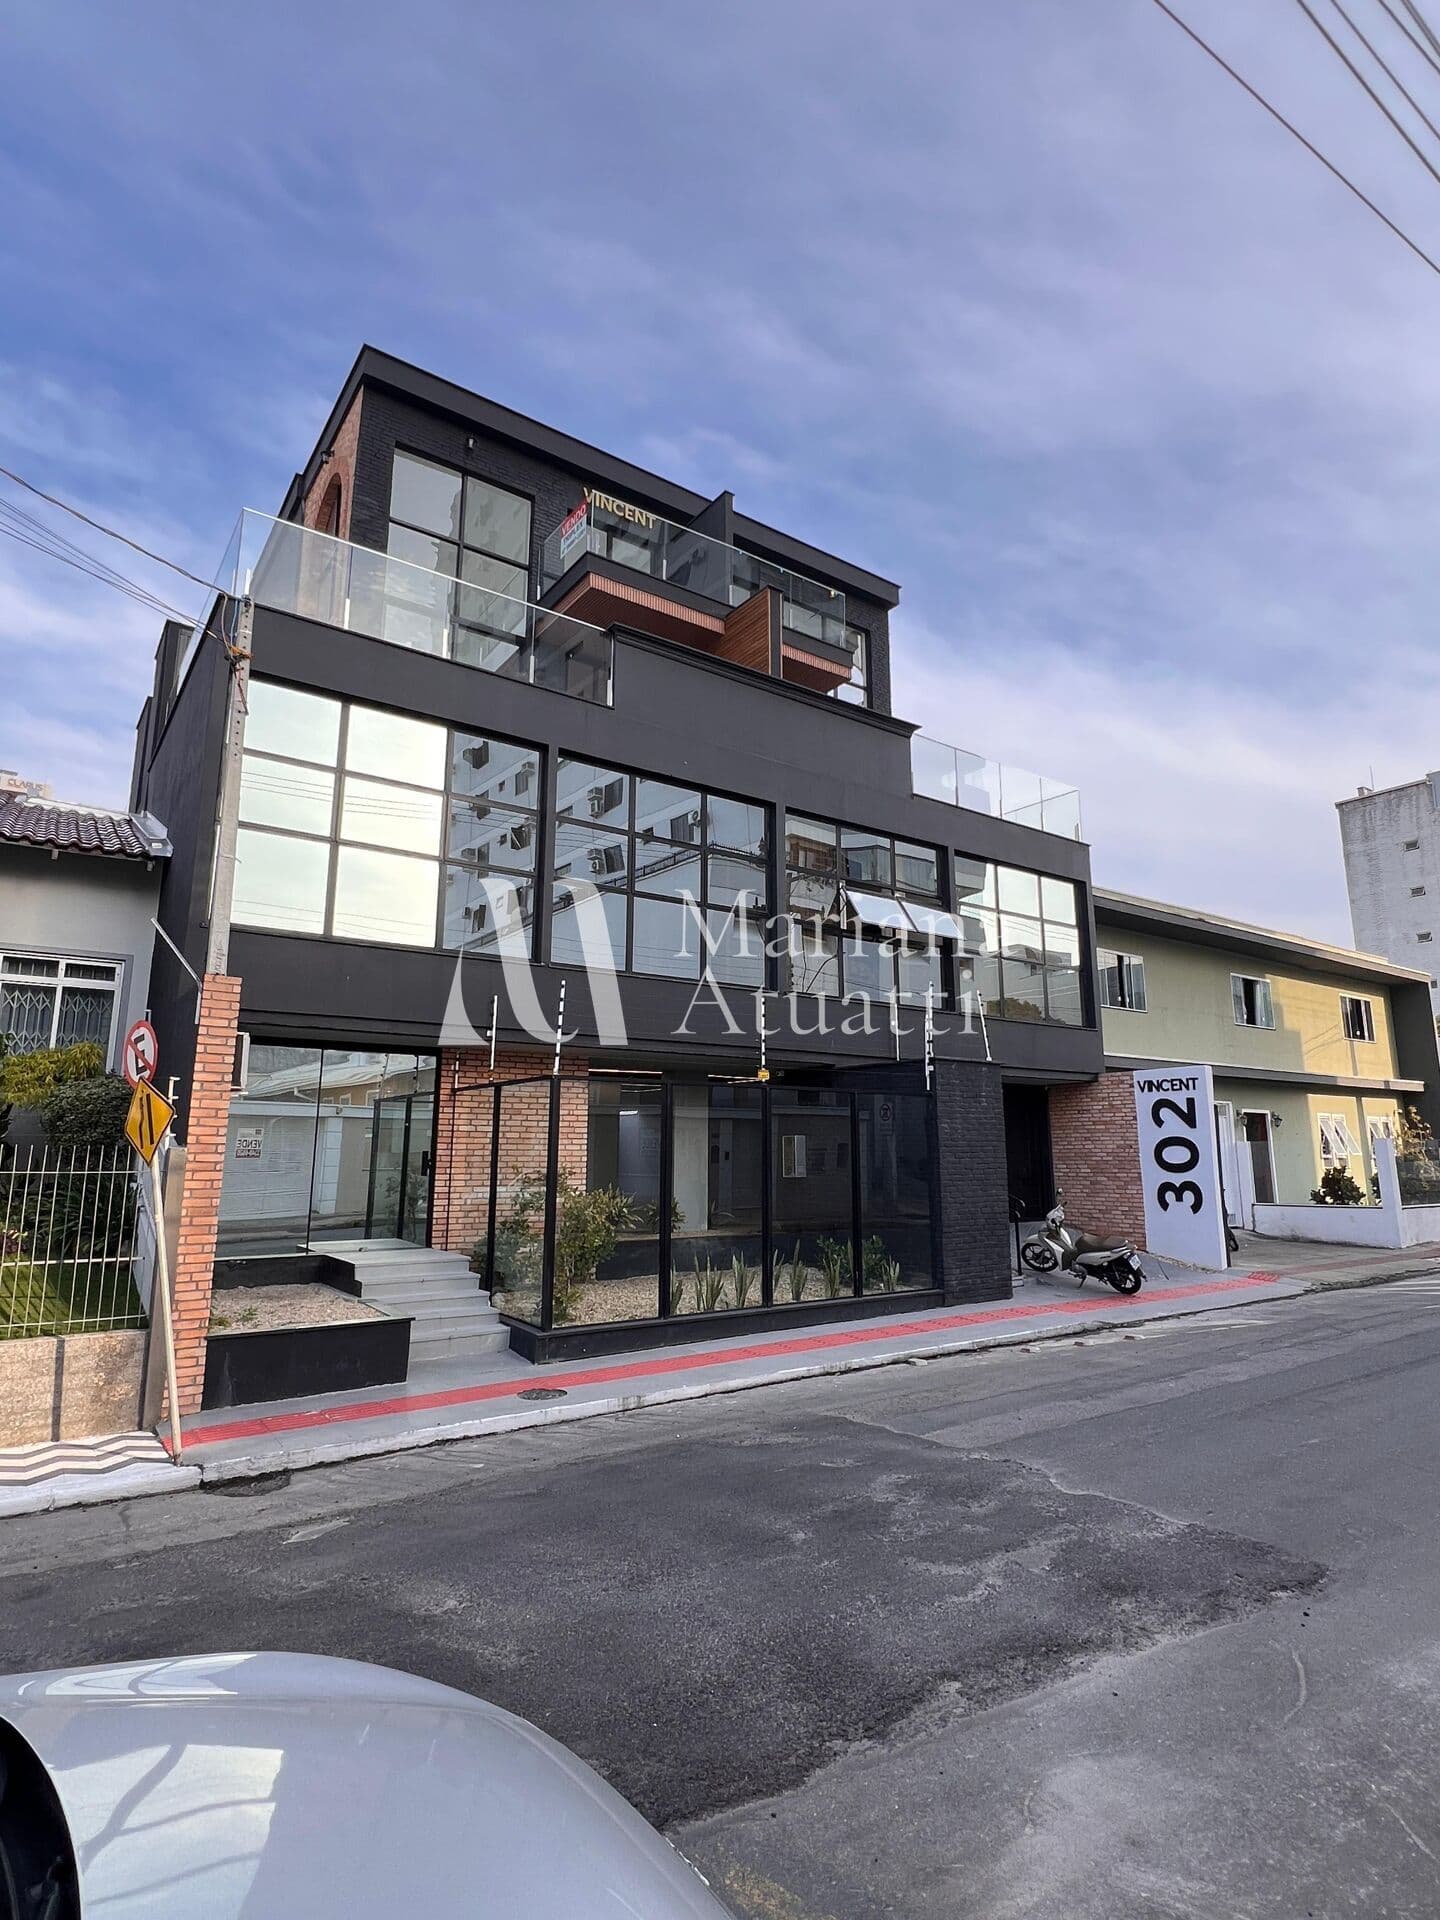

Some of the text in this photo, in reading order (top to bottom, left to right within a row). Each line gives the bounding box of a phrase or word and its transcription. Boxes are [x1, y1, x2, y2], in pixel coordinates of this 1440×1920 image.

[561, 503, 586, 536] VENDO
[583, 486, 656, 529] VINCENT
[133, 1033, 148, 1076] E
[1137, 1077, 1199, 1093] VINCENT
[1151, 1097, 1203, 1215] 302
